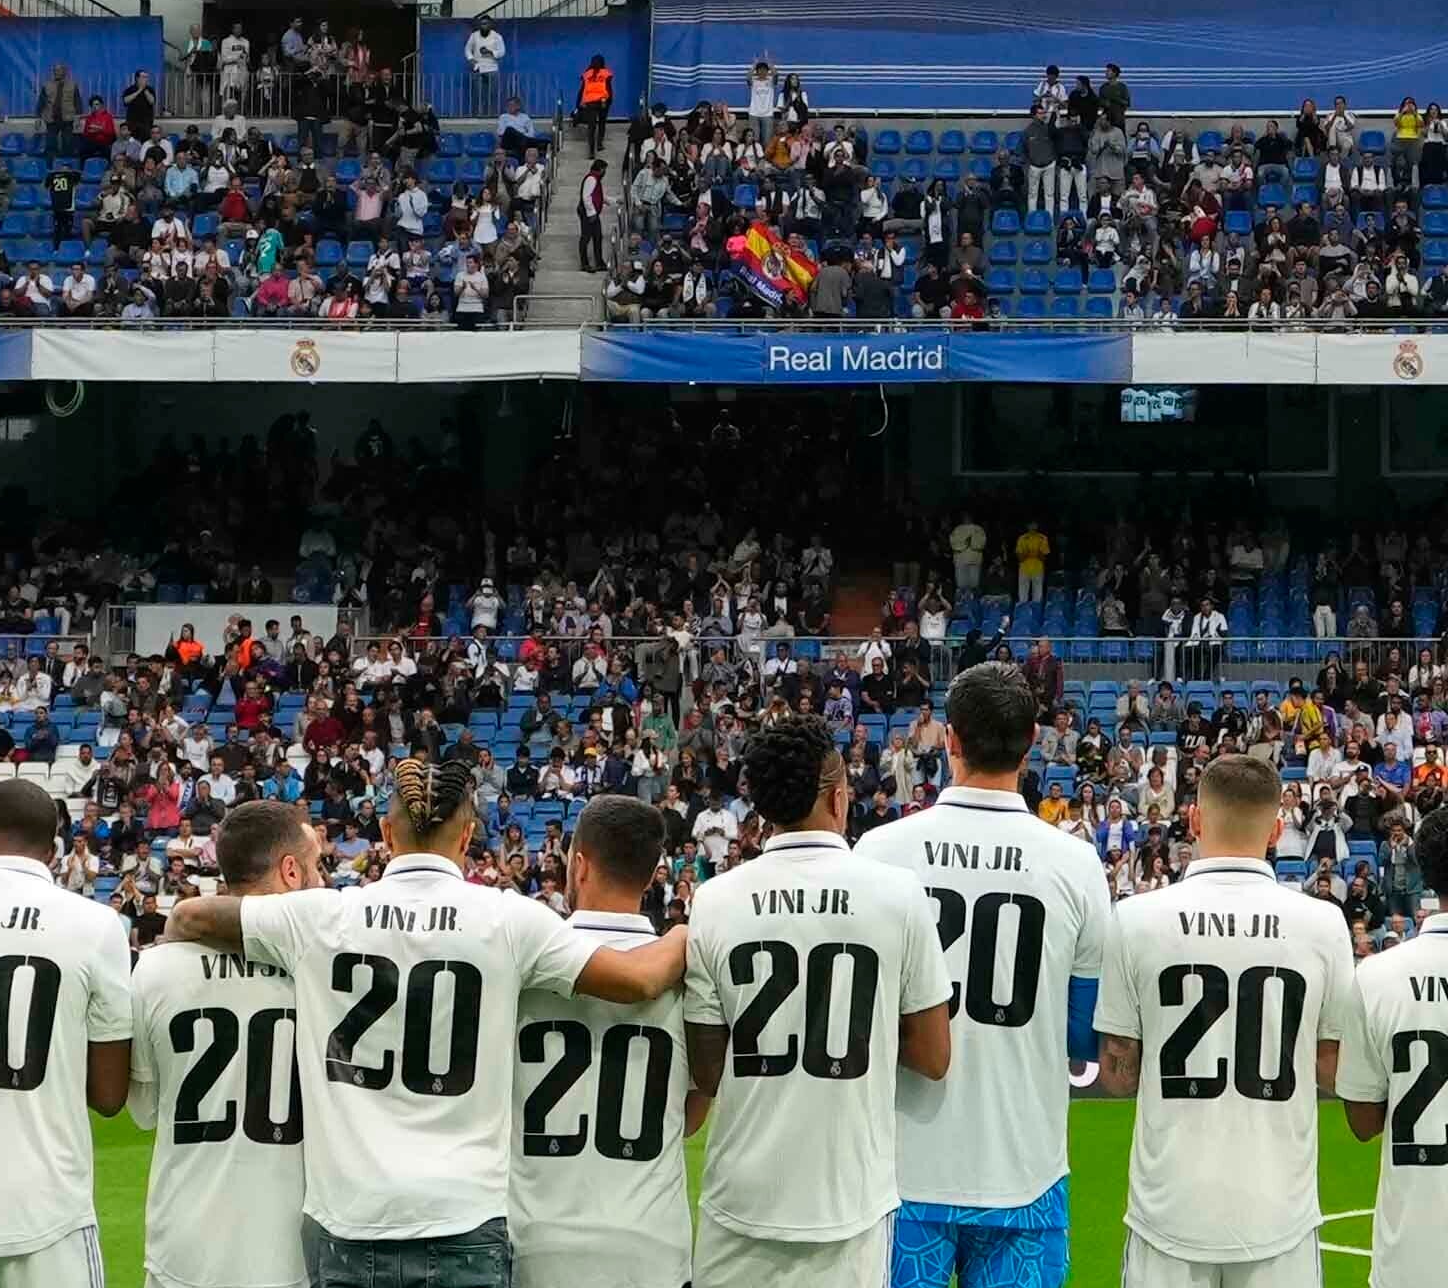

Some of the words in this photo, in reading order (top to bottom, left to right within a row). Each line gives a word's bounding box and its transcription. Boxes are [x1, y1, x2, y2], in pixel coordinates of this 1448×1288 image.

[771, 346, 830, 370] Real
[844, 345, 941, 370] Madrid
[925, 841, 979, 869] VINI
[986, 844, 1028, 872] JR.
[752, 889, 804, 915] VINI
[812, 889, 854, 915] JR.
[0, 907, 44, 931] JR.
[366, 905, 415, 931] VINI
[419, 907, 463, 933] JR.
[1179, 912, 1235, 936] VINI
[1240, 914, 1286, 940] JR.
[326, 953, 482, 1096] 20
[729, 941, 879, 1079] 20
[1158, 964, 1306, 1101] 20
[169, 1007, 304, 1145] 20
[518, 1020, 673, 1161] 20
